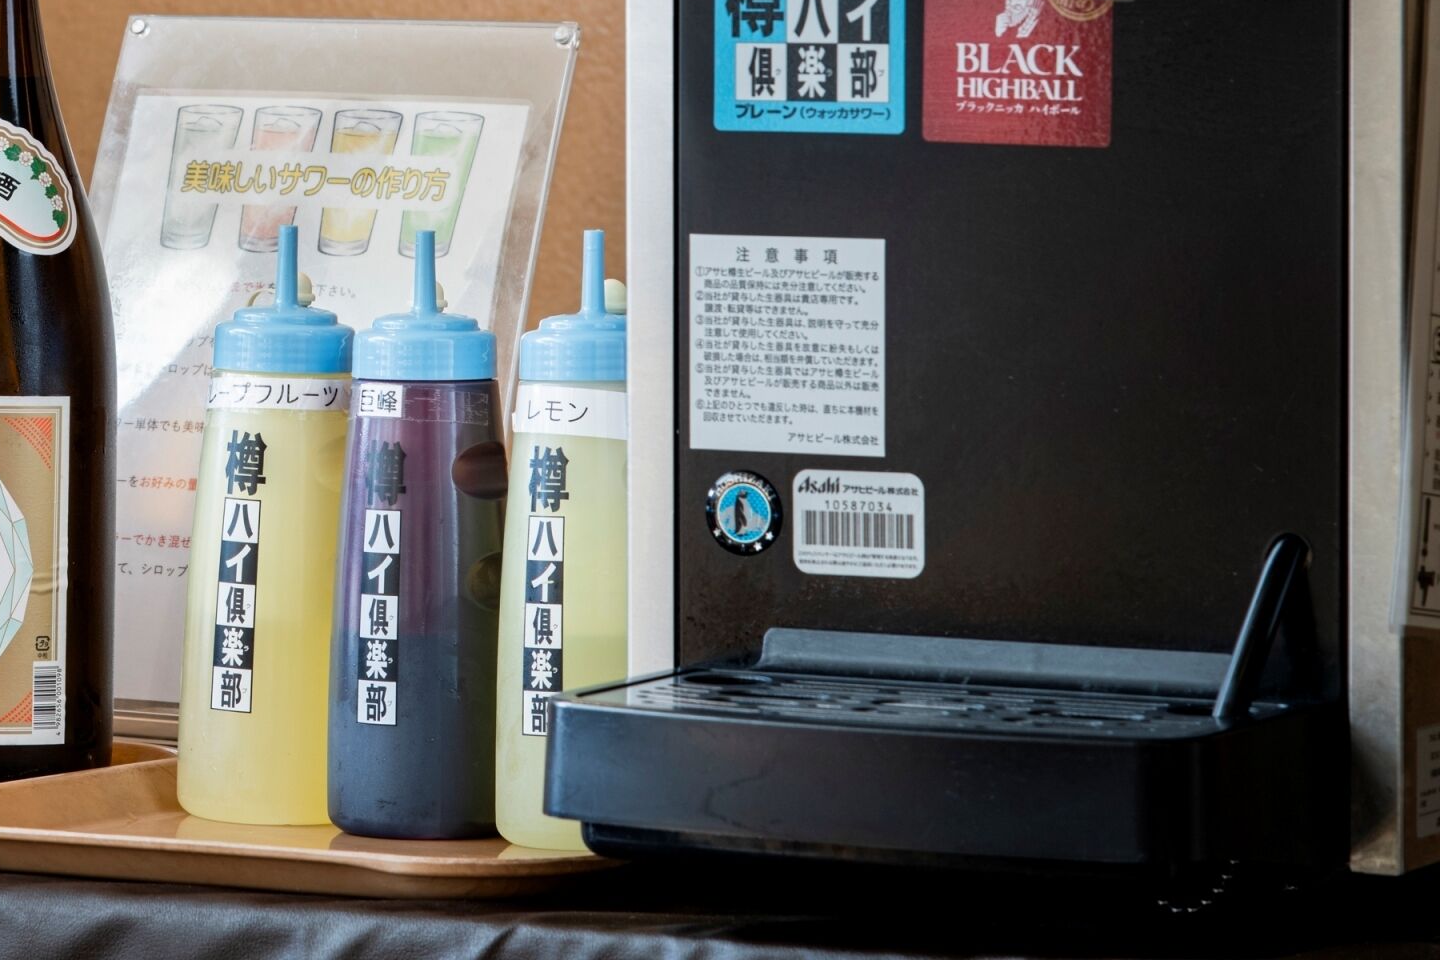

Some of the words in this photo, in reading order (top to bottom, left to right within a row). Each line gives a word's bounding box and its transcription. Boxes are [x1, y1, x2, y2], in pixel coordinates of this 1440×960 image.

[956, 42, 1083, 77] BLACK
[957, 76, 1083, 101] HIGHBALL
[956, 101, 1024, 113] ブラックニッカ
[1029, 103, 1082, 115] ハイボール
[181, 158, 451, 202] 美味しいサワーの作り方
[736, 246, 838, 265] 注意事項
[360, 387, 398, 415] 巨峰
[526, 398, 590, 424] レモン
[797, 475, 841, 495] Asahi
[825, 499, 893, 512] 10587034
